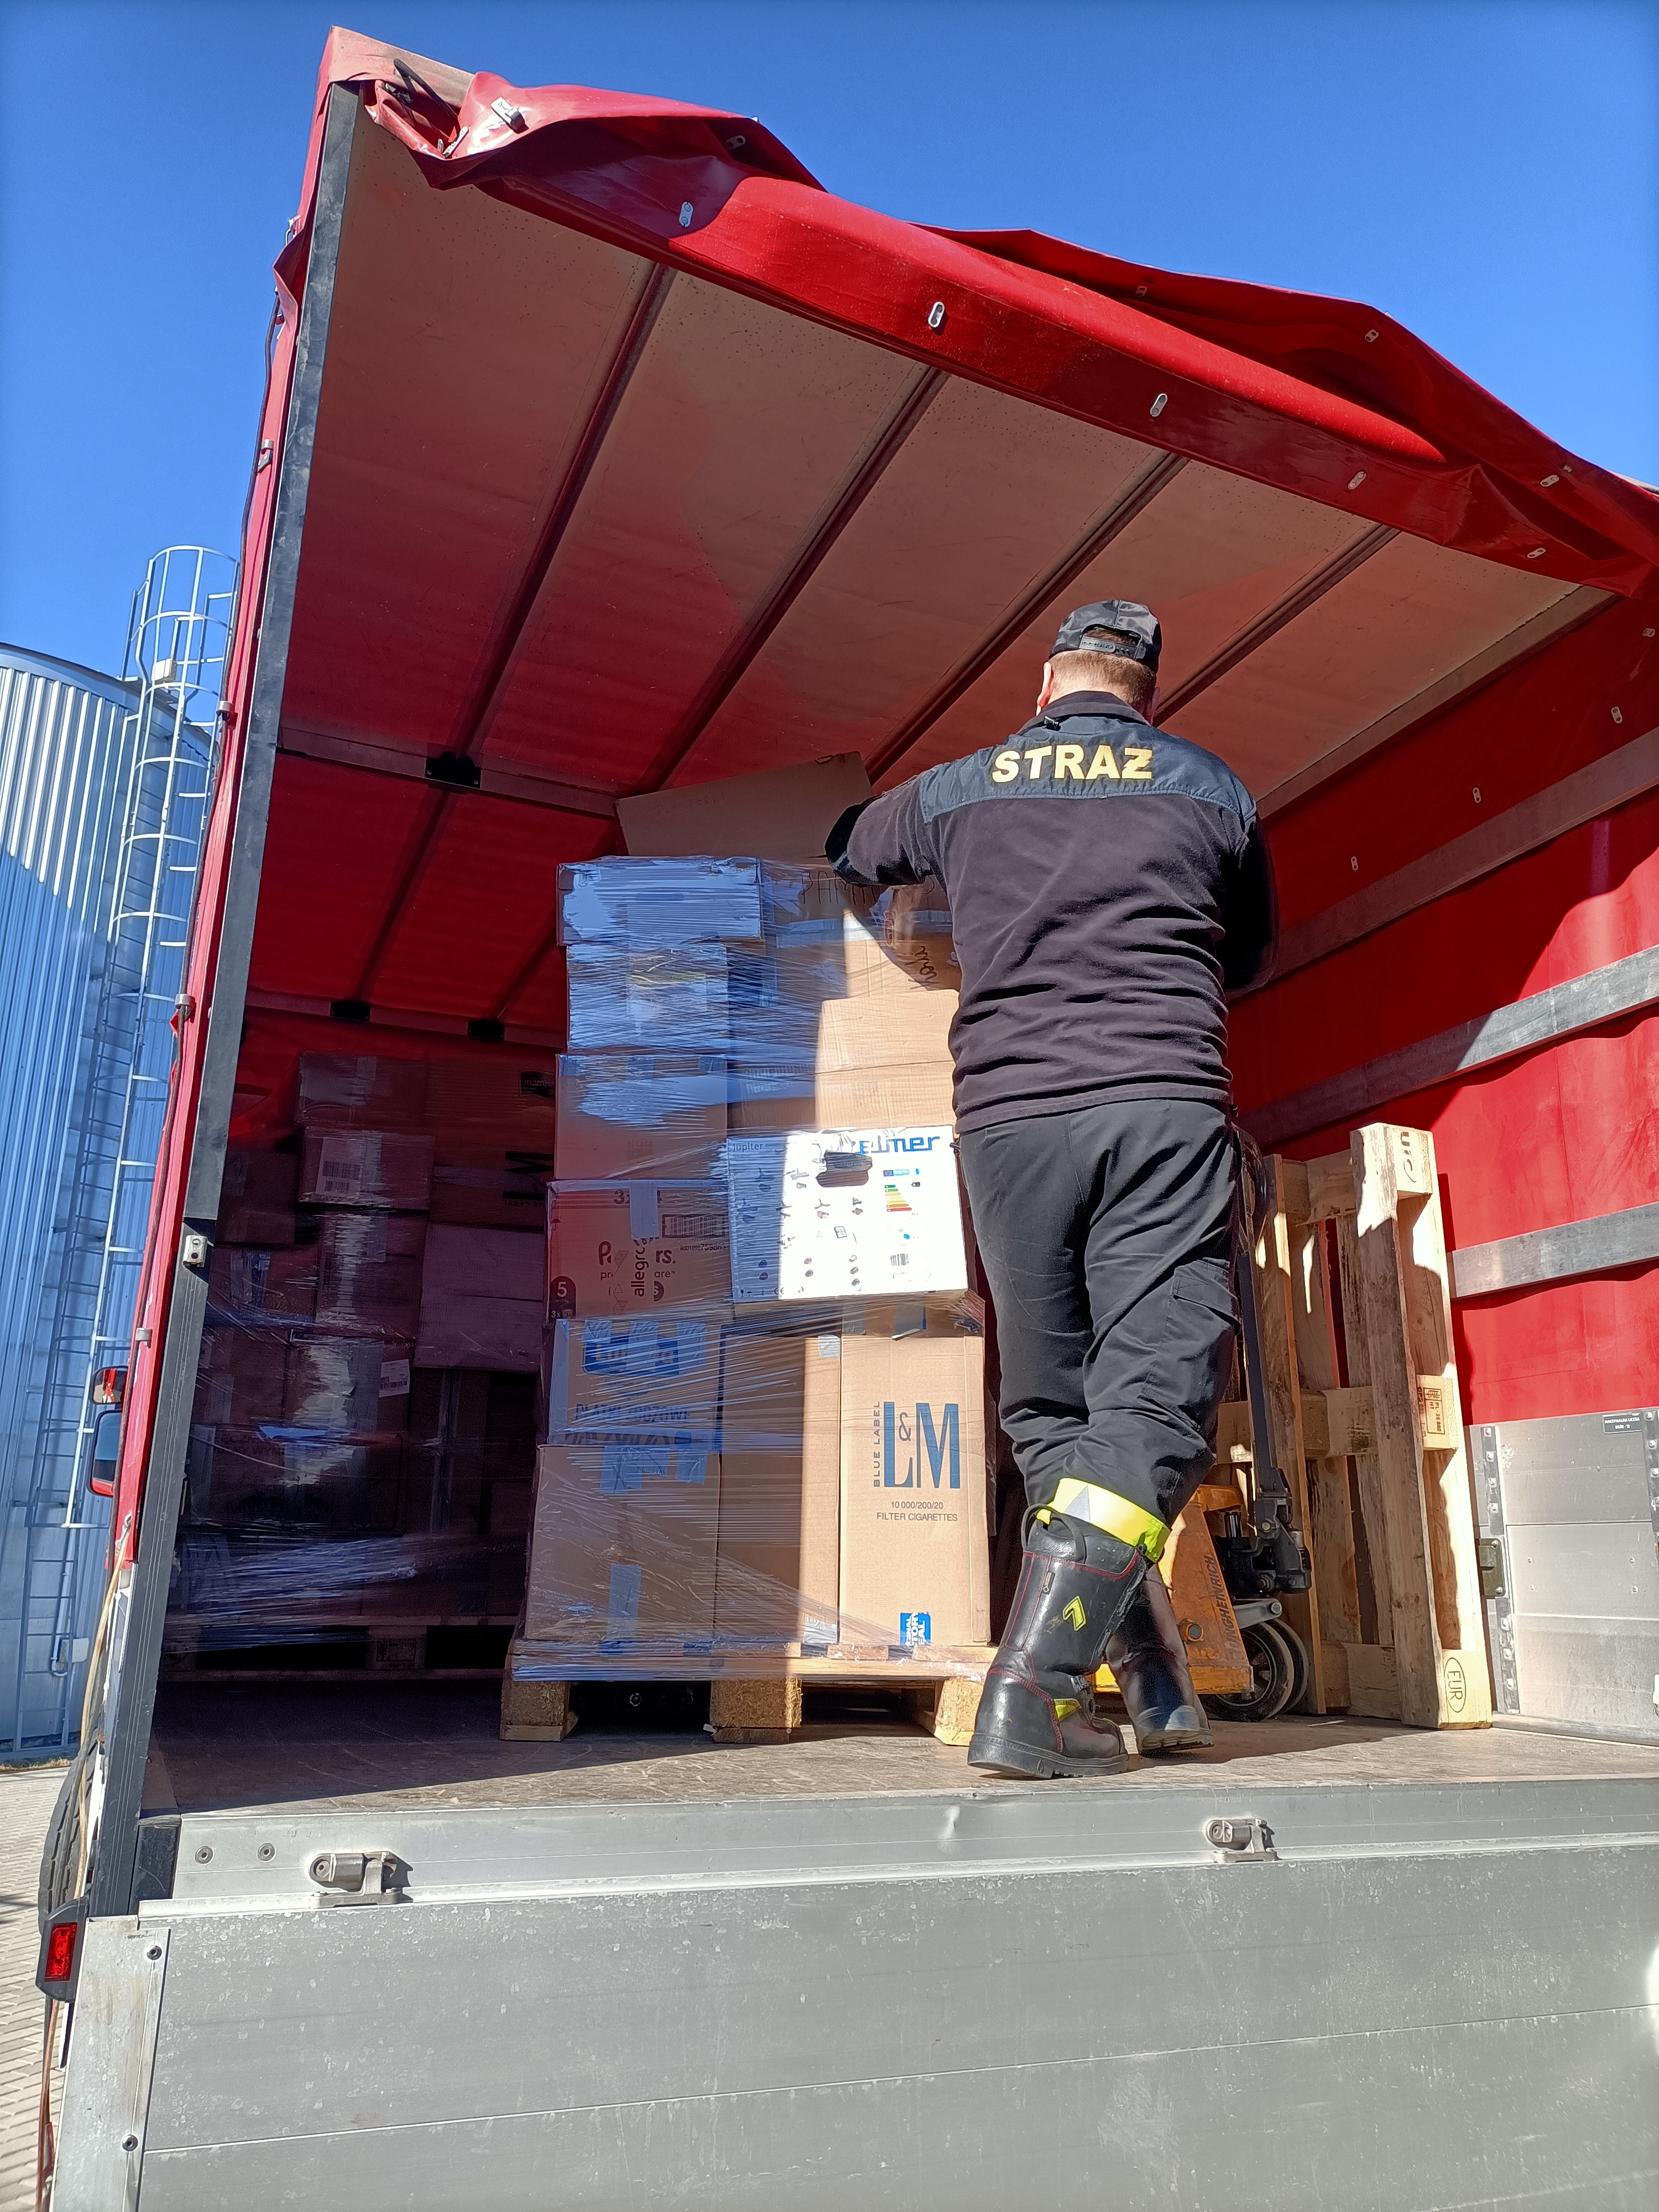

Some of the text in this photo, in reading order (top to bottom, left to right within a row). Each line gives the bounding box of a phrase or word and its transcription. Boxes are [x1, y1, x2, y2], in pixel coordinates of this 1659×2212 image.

[733, 1142, 763, 1152] Jupiter
[557, 1281, 567, 1297] 5
[883, 1401, 961, 1489] L&M
[908, 1512, 958, 1521] CIGARETTES
